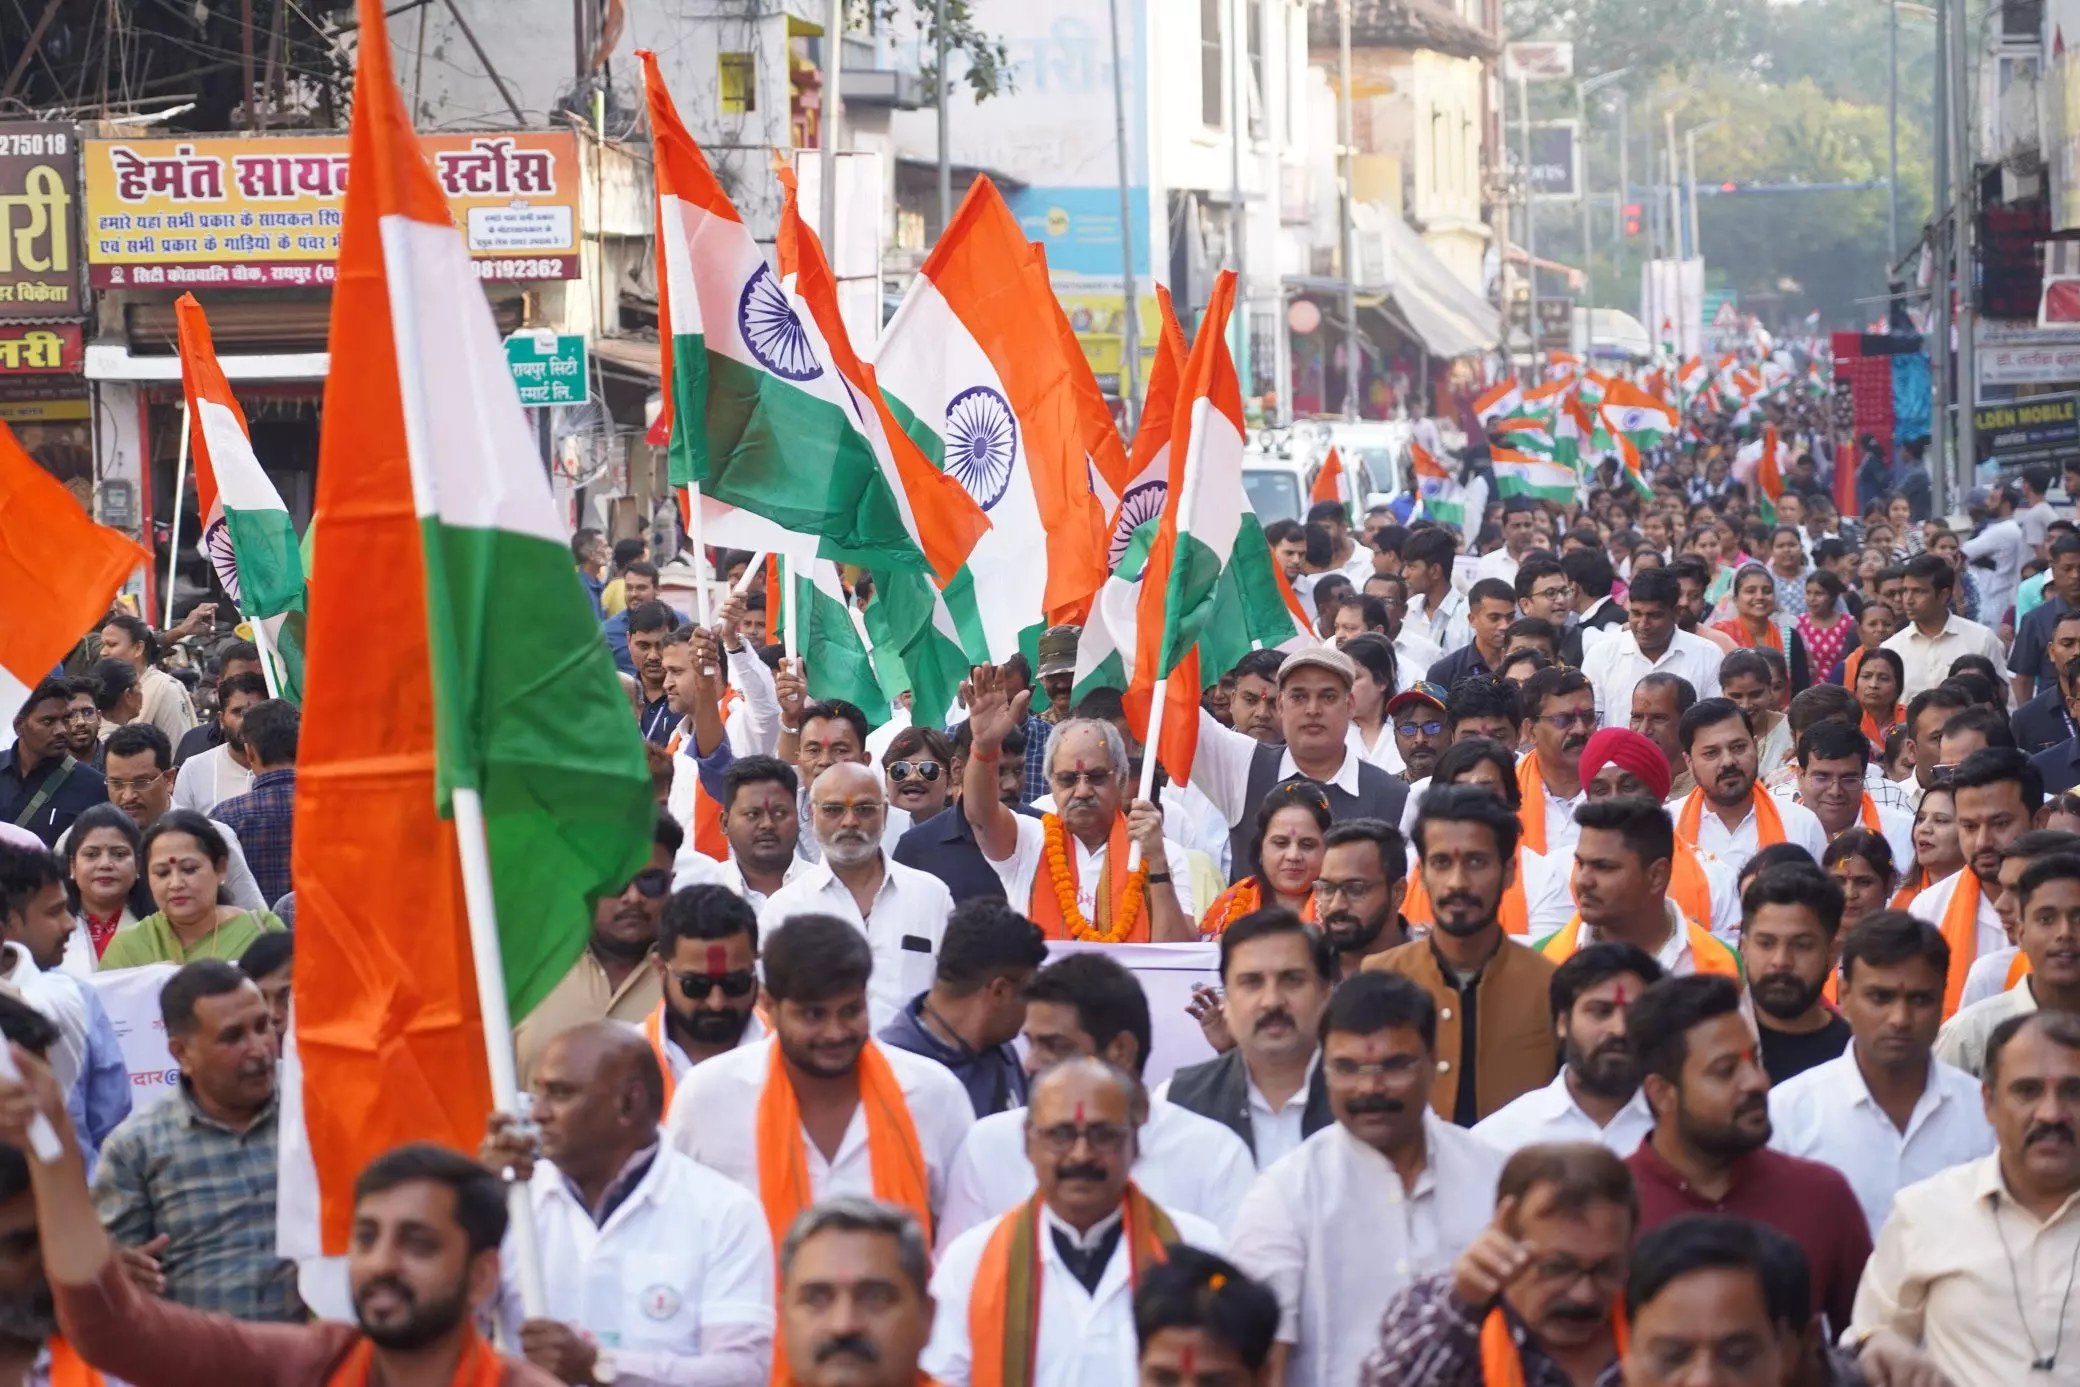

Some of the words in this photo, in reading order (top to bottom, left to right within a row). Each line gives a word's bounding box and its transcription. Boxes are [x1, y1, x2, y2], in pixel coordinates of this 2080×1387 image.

[0, 133, 67, 156] 275018
[111, 146, 225, 201] हेमंत
[234, 156, 349, 199] साय
[99, 210, 132, 230] हमारे
[166, 211, 195, 229] सभी
[199, 212, 236, 229] प्रकार
[240, 209, 254, 228] के
[258, 212, 314, 227] सायकल
[126, 234, 155, 253] सभी
[161, 236, 197, 253] प्रकार
[204, 234, 217, 251] के
[278, 233, 291, 249] के
[132, 265, 164, 283] सिटी
[270, 265, 312, 284] रायपुर
[512, 361, 547, 381] रायपुर
[549, 355, 578, 376] सिटी
[1974, 406, 2016, 430] LDEN
